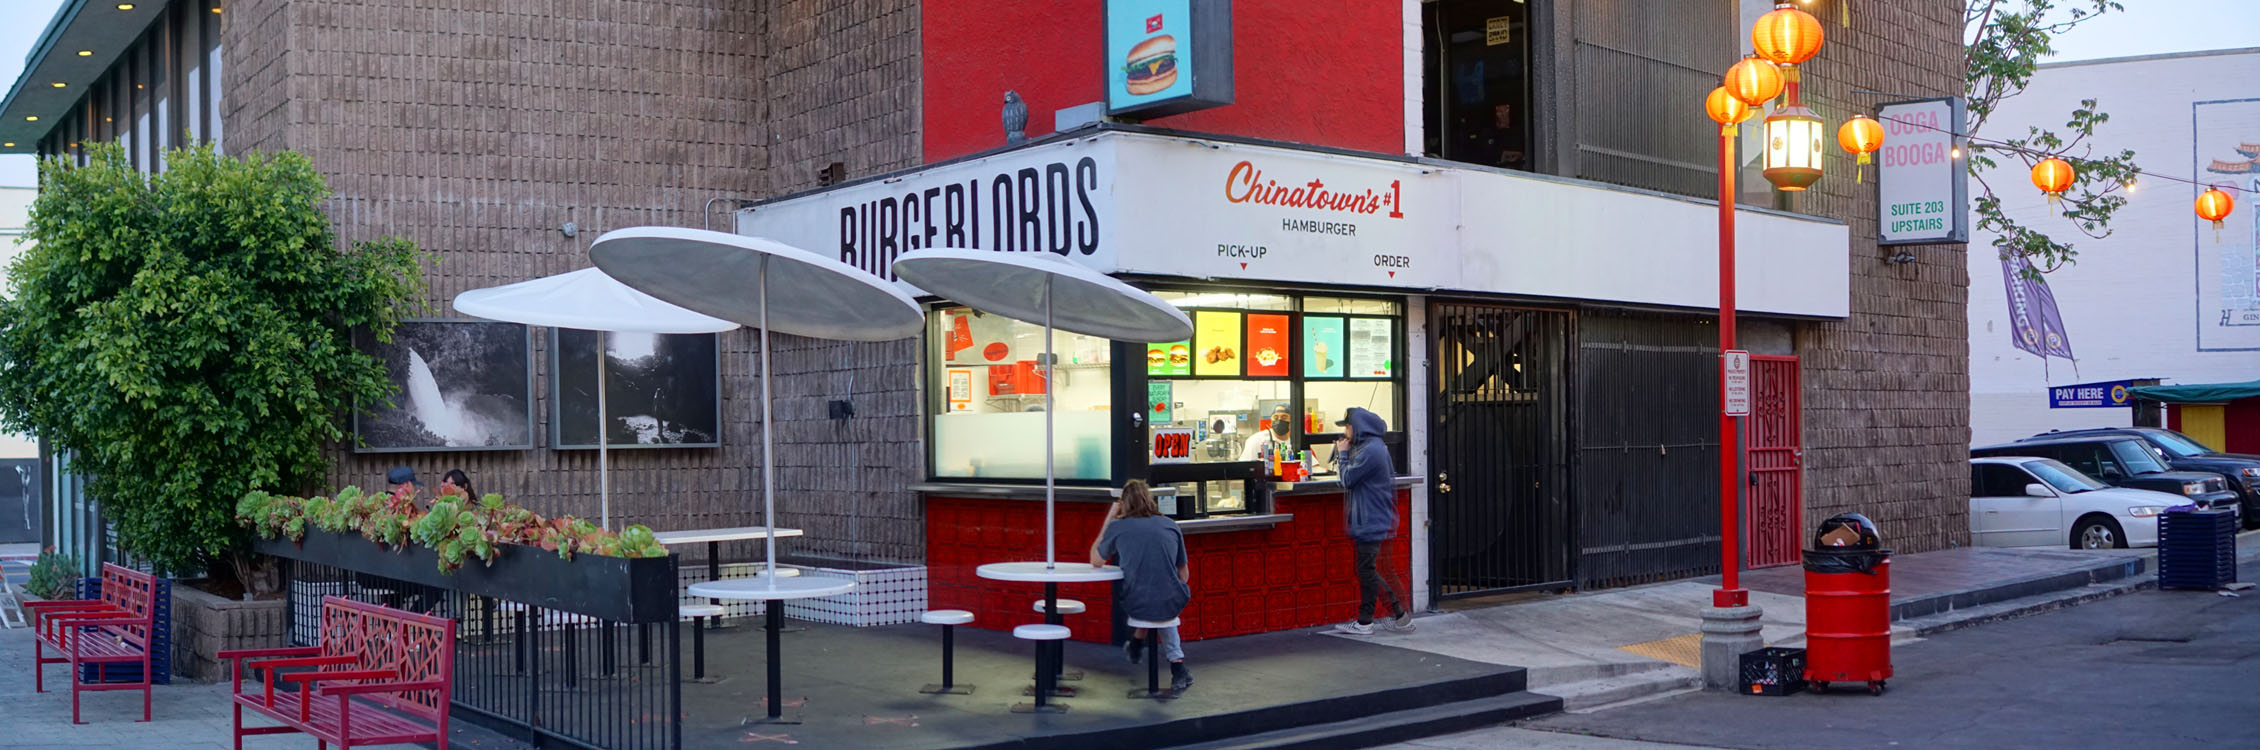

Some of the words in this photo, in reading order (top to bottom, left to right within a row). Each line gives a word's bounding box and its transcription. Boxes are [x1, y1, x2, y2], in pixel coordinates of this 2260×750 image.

[1890, 111, 1939, 136] OOGA
[1885, 142, 1945, 168] BOOGA
[1225, 160, 1380, 214] Chinatown's
[1383, 180, 1404, 219] #1
[1891, 202, 1921, 216] SUITE
[1924, 200, 1944, 214] 203
[1282, 218, 1356, 236] HAMBURGER
[1891, 218, 1943, 233] UPSTAIRS
[1217, 244, 1267, 259] PICK-UP
[1373, 254, 1410, 268] ORDER
[2055, 388, 2075, 400] PAY
[2077, 387, 2104, 400] HERE
[1154, 432, 1190, 458] OPEN
